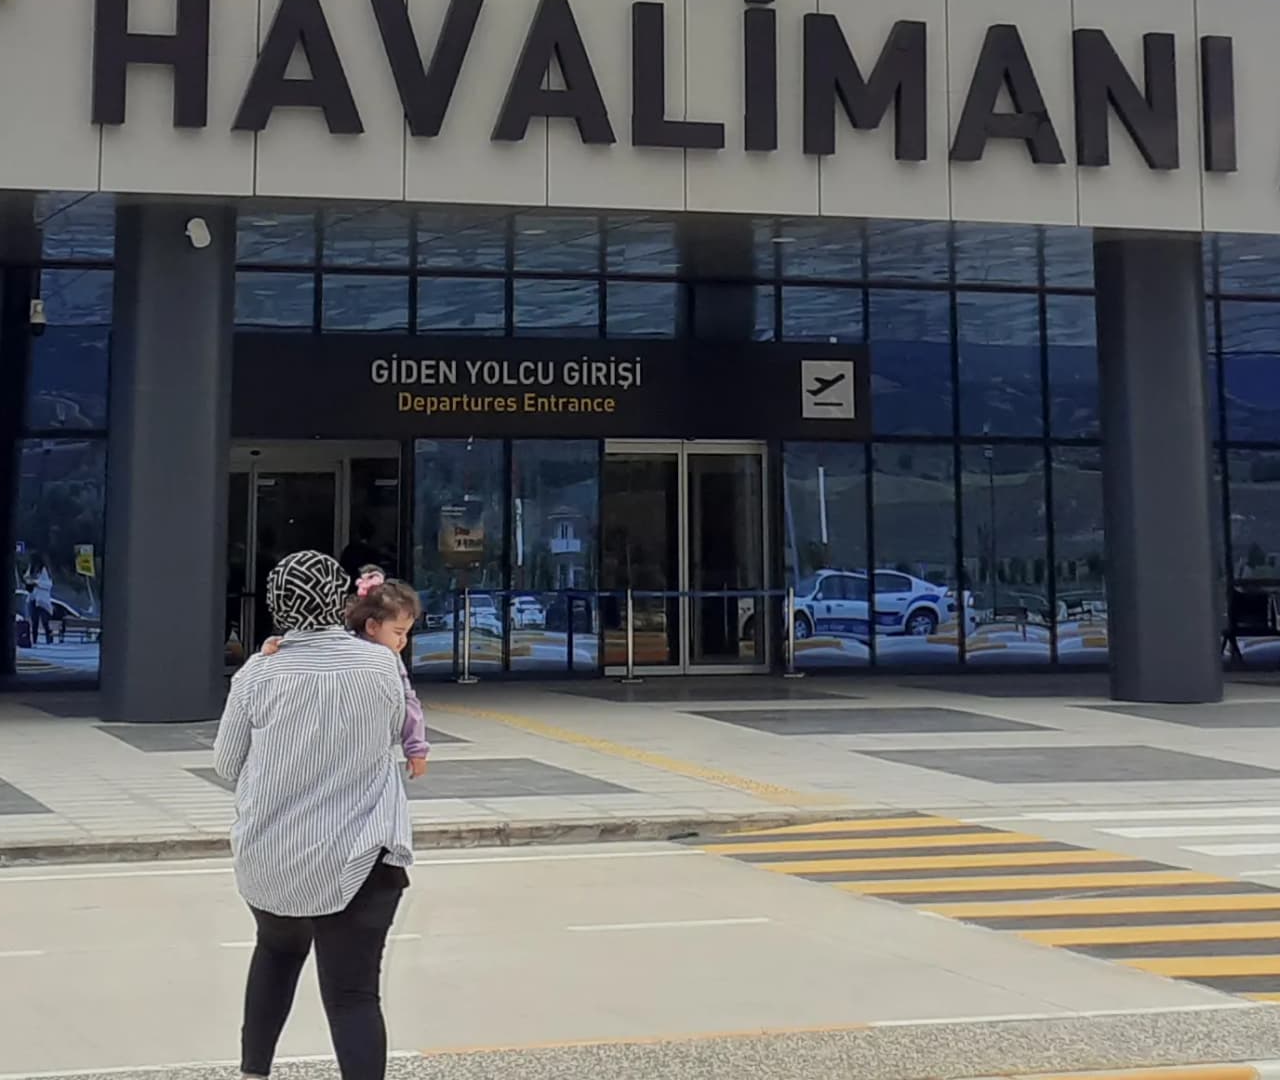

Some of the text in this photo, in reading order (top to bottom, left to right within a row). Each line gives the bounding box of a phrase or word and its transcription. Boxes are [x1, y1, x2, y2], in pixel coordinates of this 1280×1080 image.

[371, 353, 642, 390] GİDEN YOLCU GİRİŞİ
[398, 391, 616, 416] Departures Entrance
